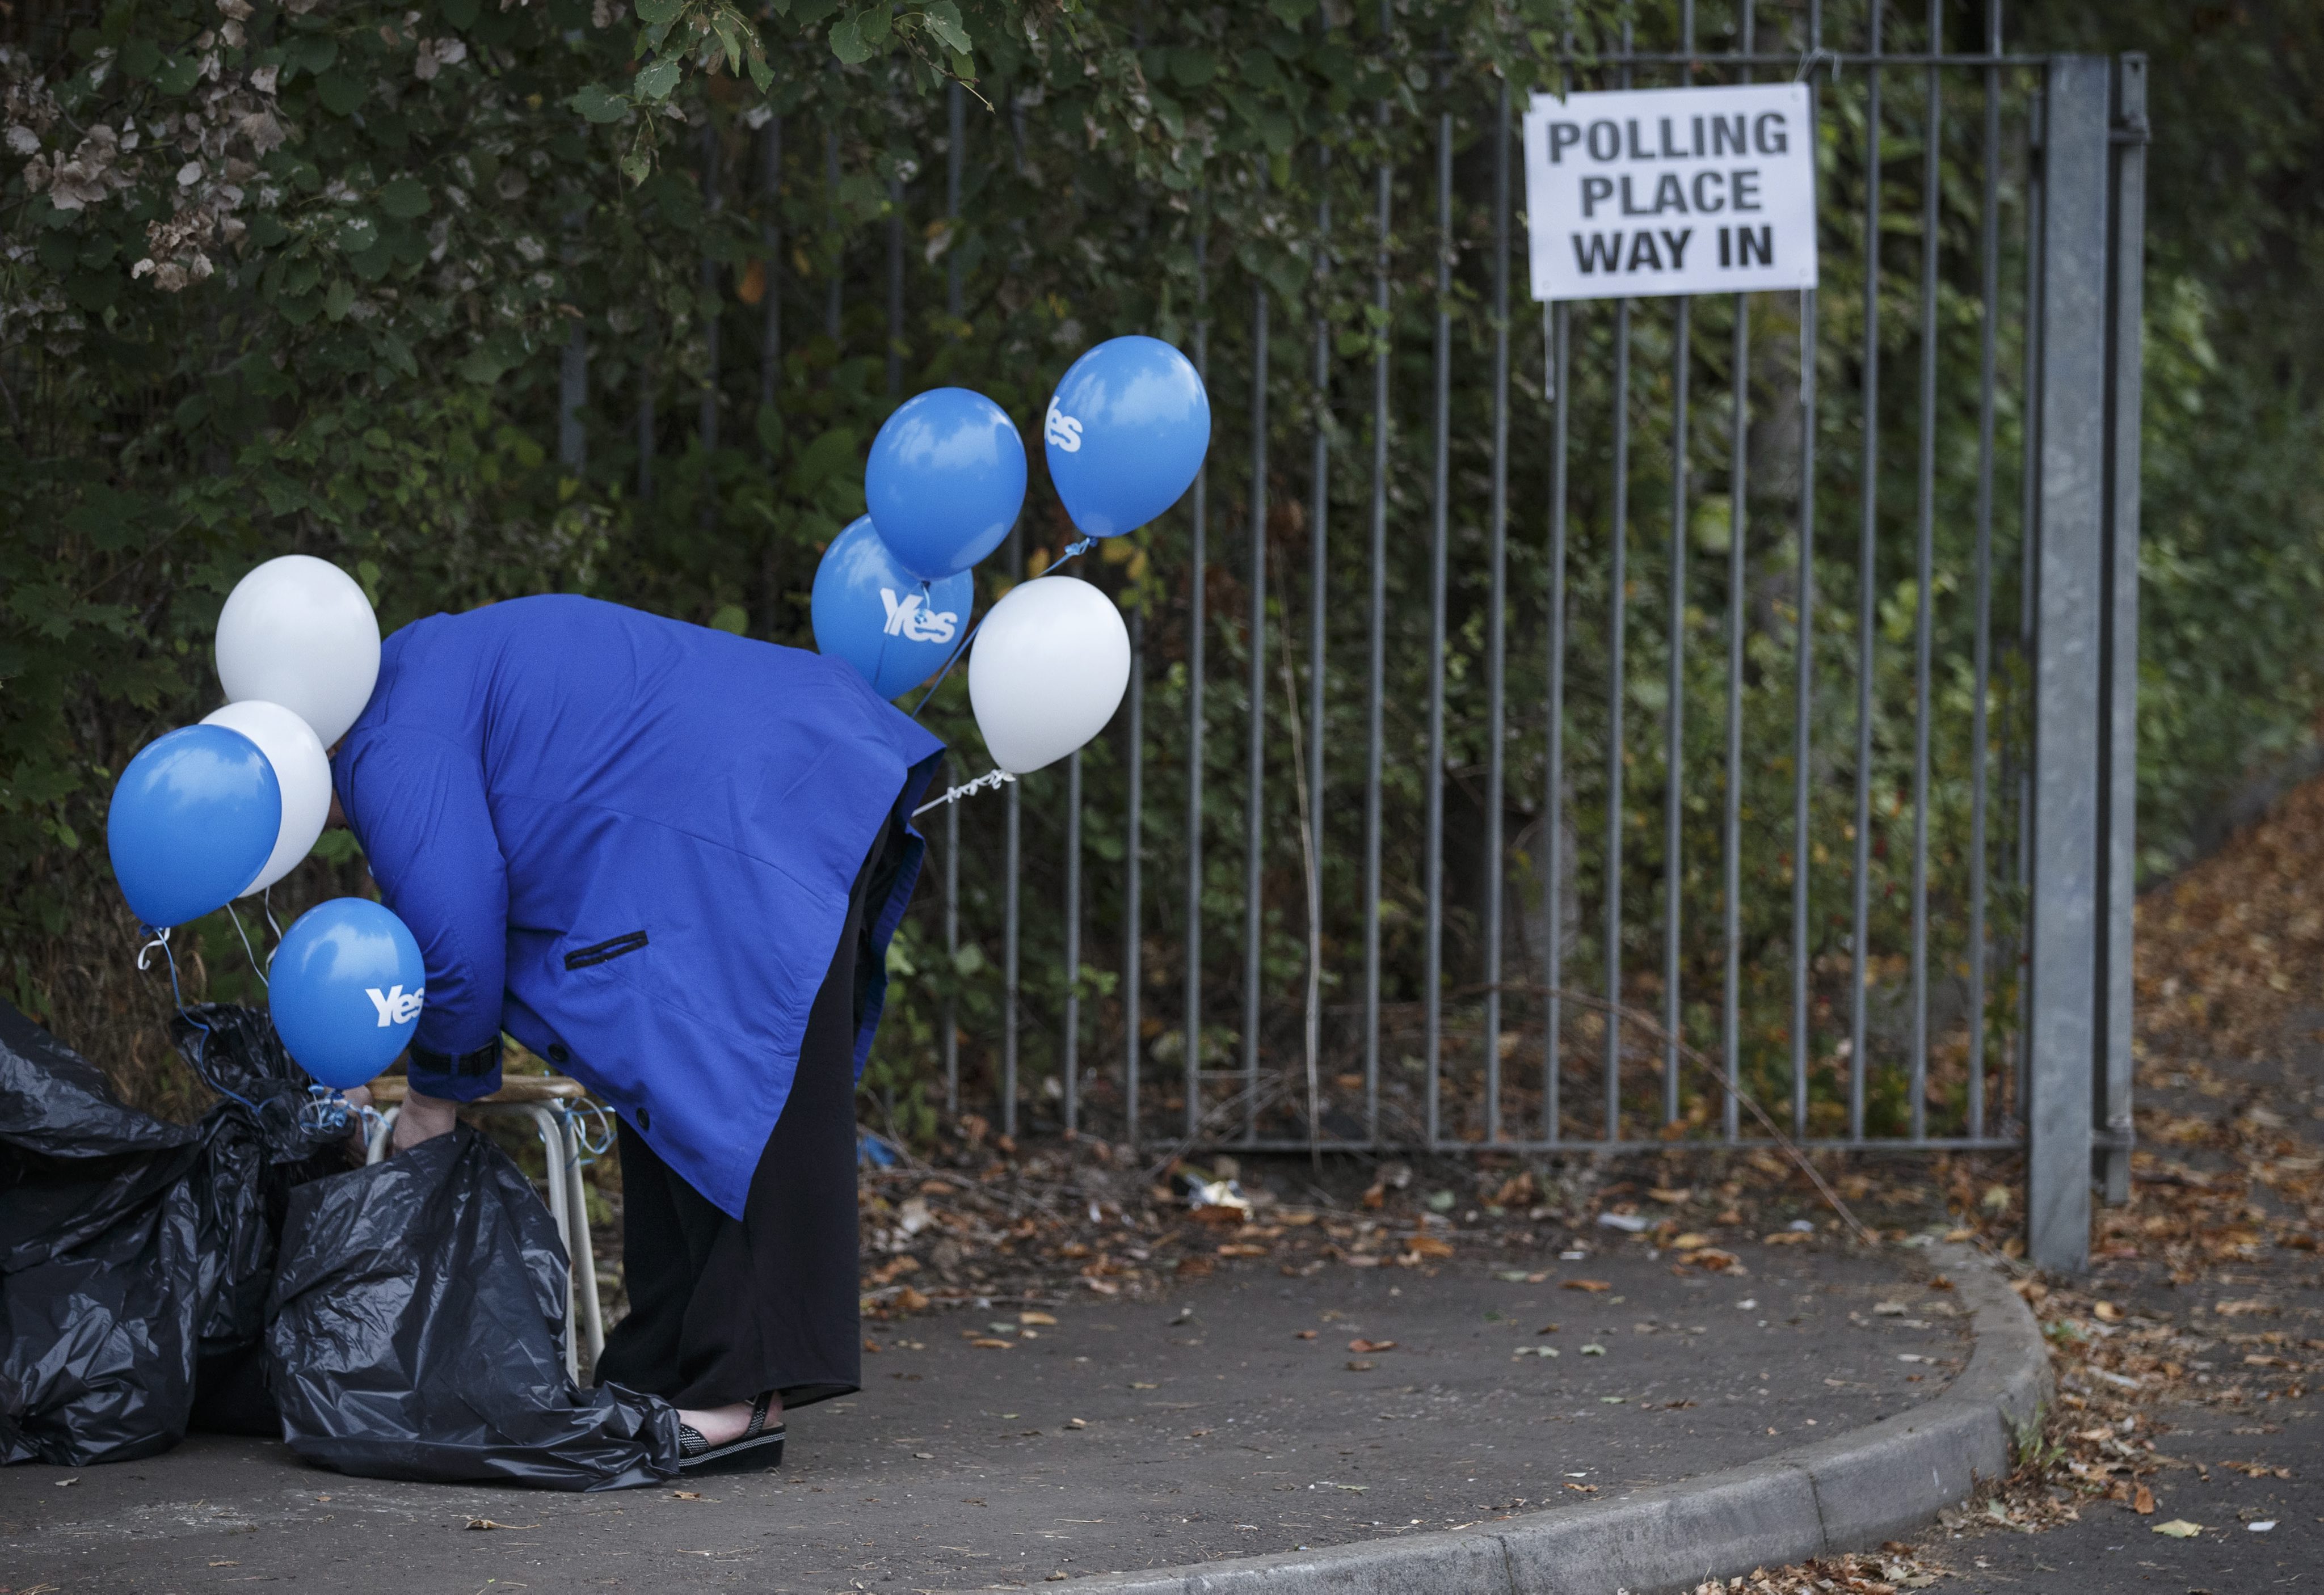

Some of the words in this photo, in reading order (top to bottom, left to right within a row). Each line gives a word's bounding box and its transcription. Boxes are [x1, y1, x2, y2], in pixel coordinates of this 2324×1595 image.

[1548, 112, 1790, 164] POLLING
[1580, 170, 1762, 220] PLACE
[1571, 228, 1693, 275] WAY
[1717, 223, 1774, 269] IN
[880, 587, 958, 643] Yes
[365, 984, 425, 1028] Yes
